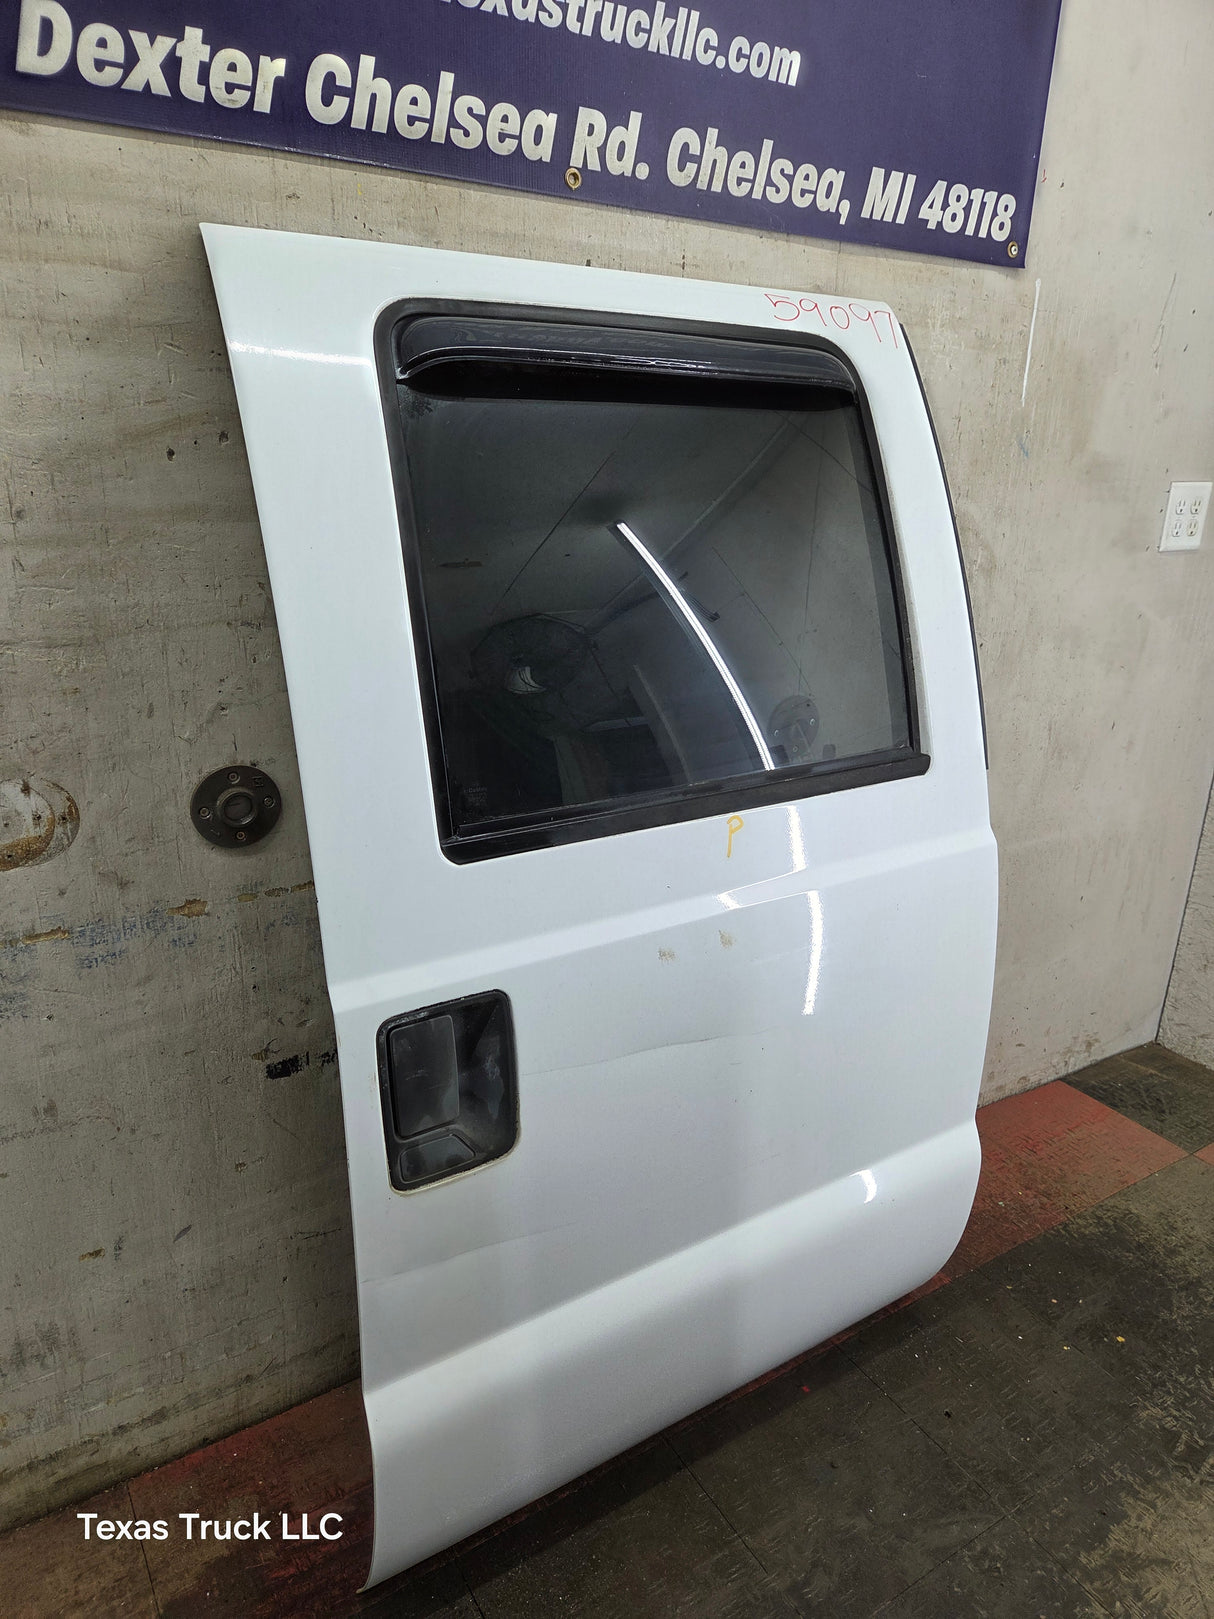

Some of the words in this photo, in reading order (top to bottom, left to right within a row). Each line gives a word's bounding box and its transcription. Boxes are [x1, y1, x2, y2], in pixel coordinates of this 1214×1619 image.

[15, 0, 287, 114] Dexter
[305, 53, 558, 163] Chelsea
[569, 106, 650, 181] Rd.
[666, 127, 851, 226] Chelsea,
[861, 166, 917, 225] MI
[917, 179, 1018, 243] 48118
[764, 293, 899, 349] 59097
[726, 815, 744, 858] P
